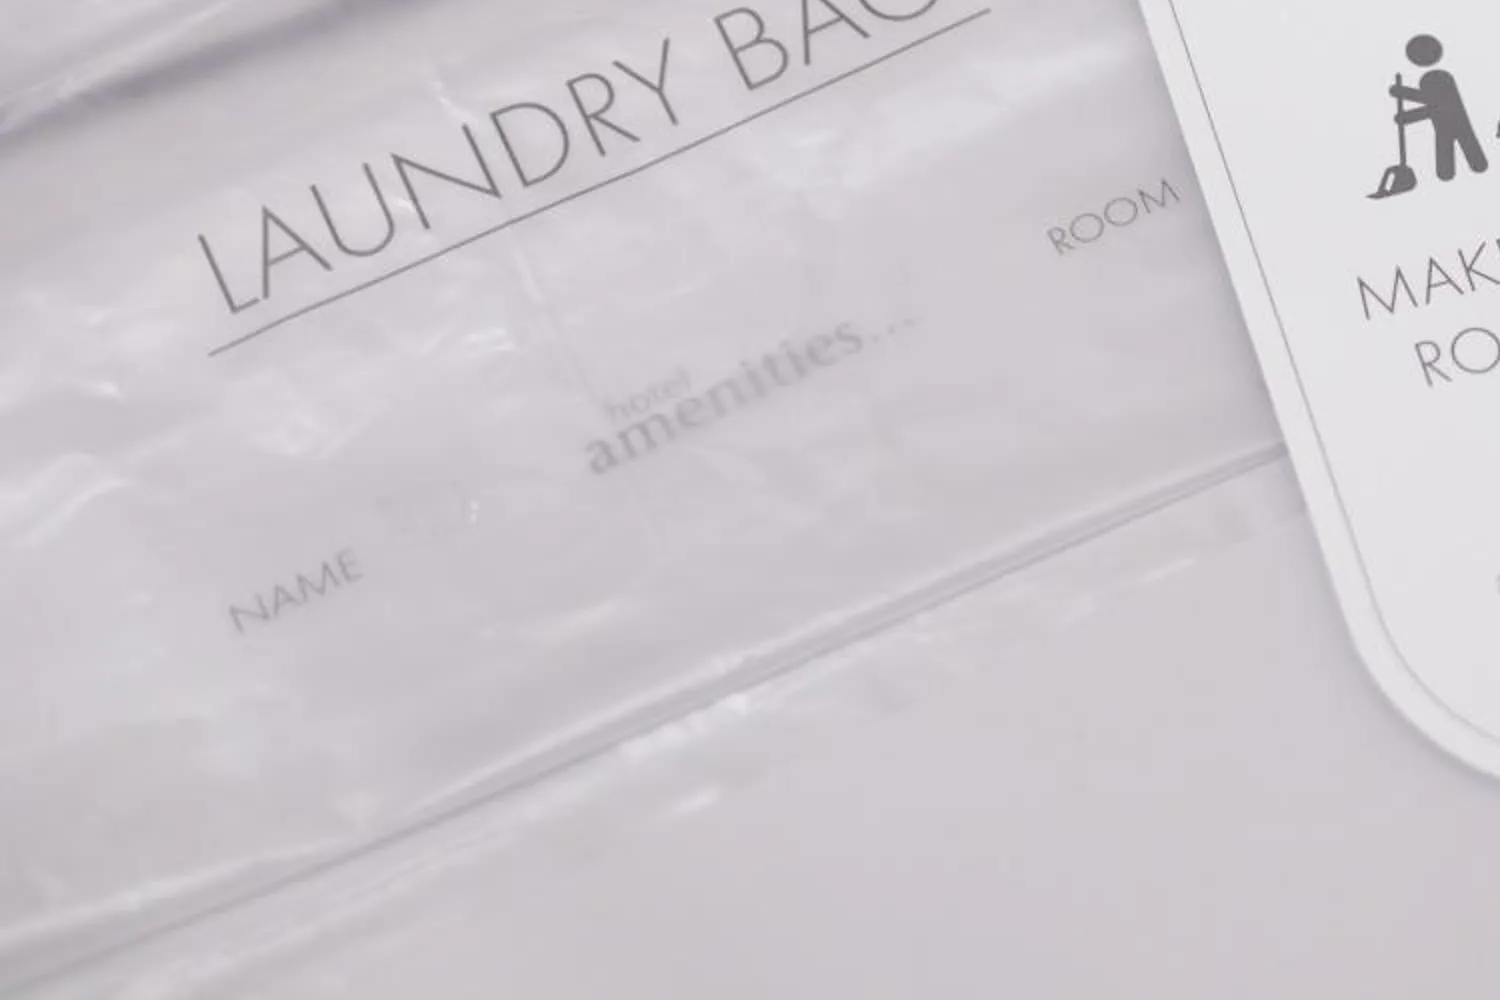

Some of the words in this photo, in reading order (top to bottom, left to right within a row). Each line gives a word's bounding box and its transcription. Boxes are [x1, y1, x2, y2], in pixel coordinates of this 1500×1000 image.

[198, 38, 678, 313] LAUNDRY
[1046, 178, 1180, 256] ROOM
[608, 364, 693, 424] hotel
[228, 547, 364, 635] NAME
